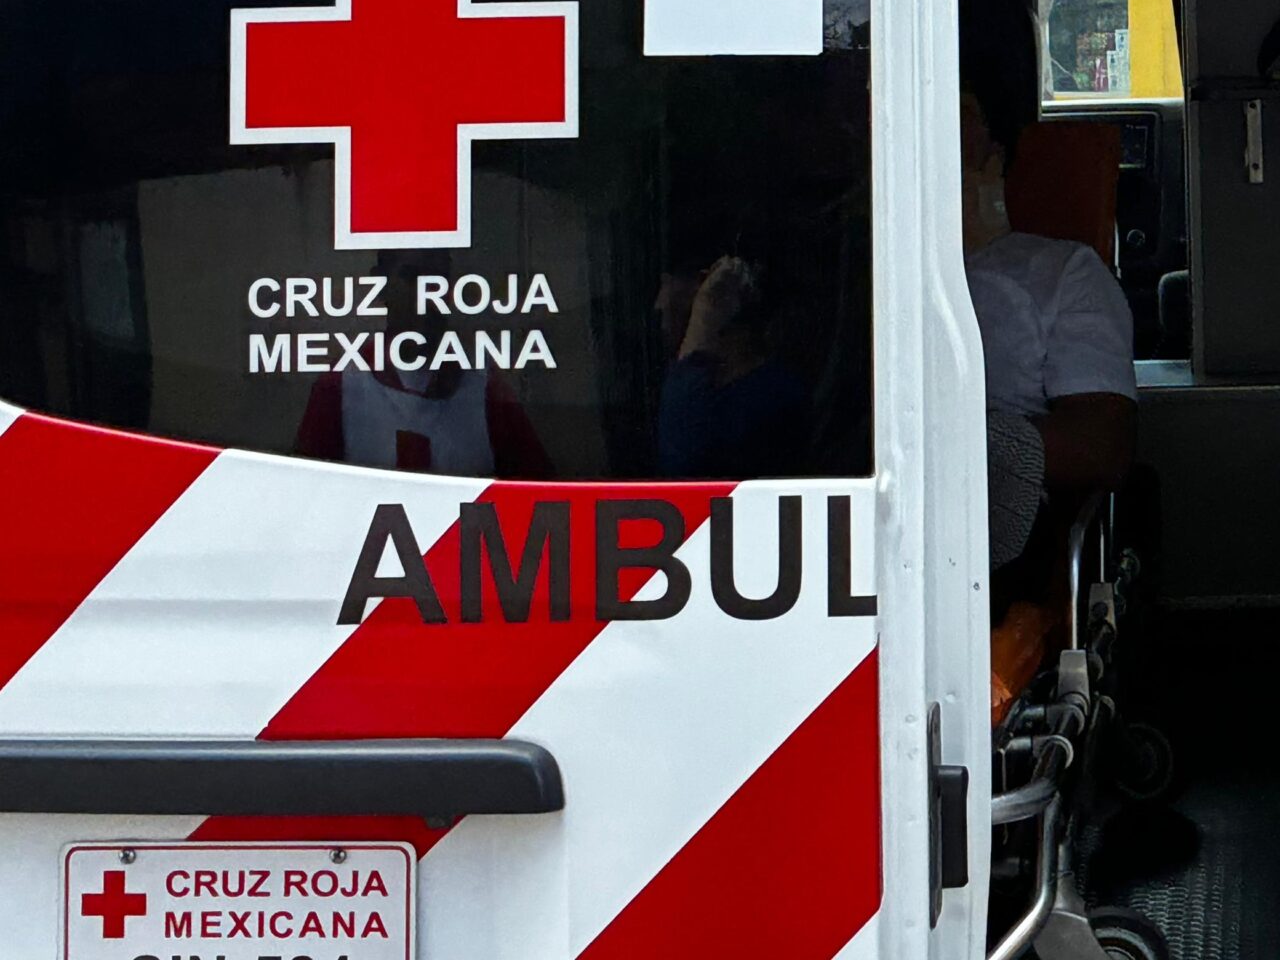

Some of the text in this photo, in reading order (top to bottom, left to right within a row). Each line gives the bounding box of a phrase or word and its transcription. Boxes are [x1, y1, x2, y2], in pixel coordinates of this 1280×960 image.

[247, 273, 560, 318] CRUZ ROJA
[248, 329, 558, 373] MEXICANA
[336, 494, 878, 626] AMBUL
[165, 869, 389, 898] CRUZ ROJA
[164, 910, 389, 939] MEXICANA
